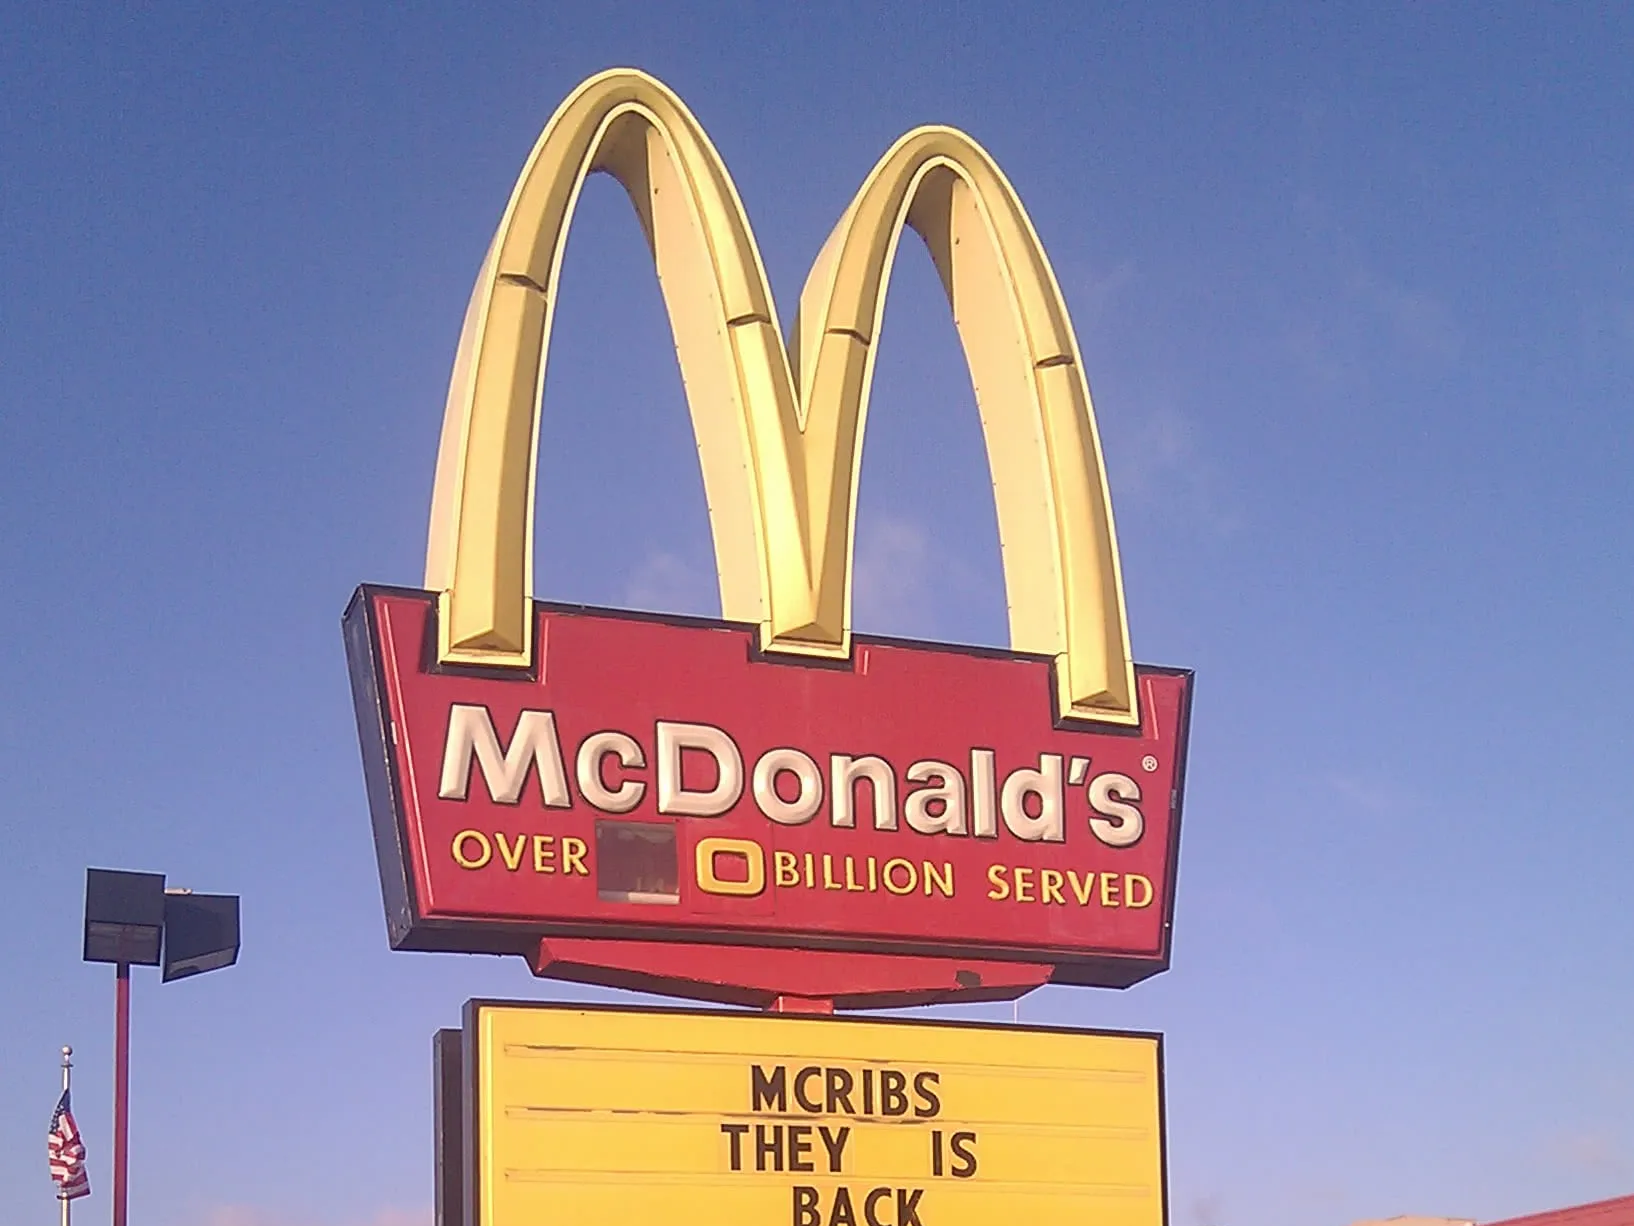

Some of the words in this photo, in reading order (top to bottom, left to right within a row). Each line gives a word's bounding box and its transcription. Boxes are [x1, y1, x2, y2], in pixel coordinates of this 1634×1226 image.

[438, 703, 1145, 847] McDonald's
[452, 829, 589, 875] OVER
[775, 851, 954, 899] BILLION
[988, 864, 1154, 908] SERVED
[752, 1064, 940, 1116] MCRIBS
[721, 1124, 850, 1173] THEY
[933, 1131, 977, 1176] IS
